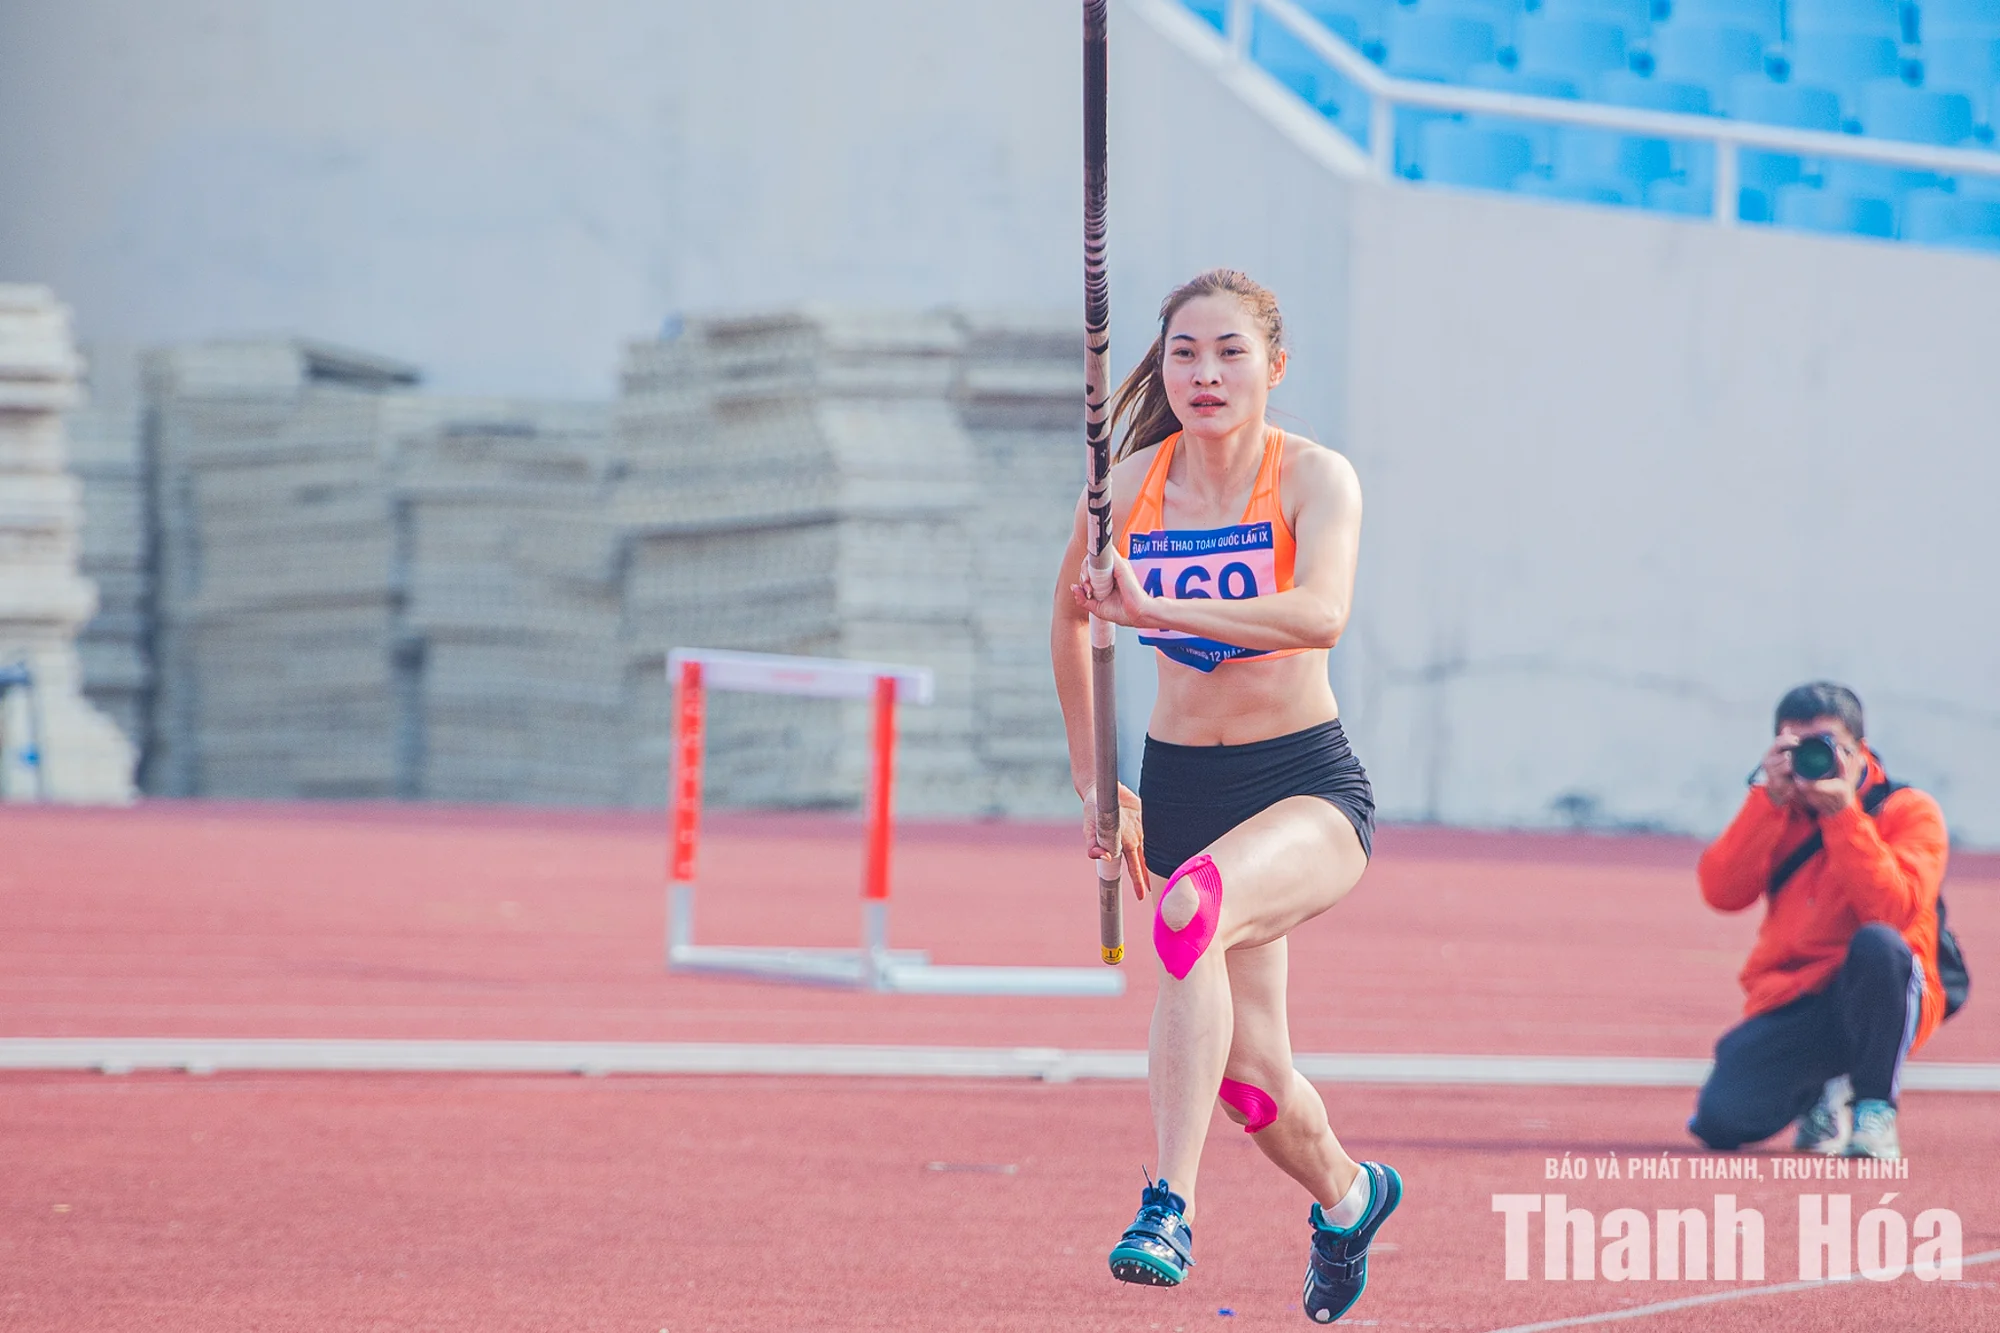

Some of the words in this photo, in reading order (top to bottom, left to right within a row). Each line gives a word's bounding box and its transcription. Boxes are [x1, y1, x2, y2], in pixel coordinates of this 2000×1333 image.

[1152, 536, 1168, 552] THỂ
[1170, 540, 1193, 552] THAO
[1196, 537, 1217, 550] TOÀN
[1217, 531, 1239, 548] QUỐC
[1259, 530, 1268, 543] IX
[1209, 650, 1221, 662] 12
